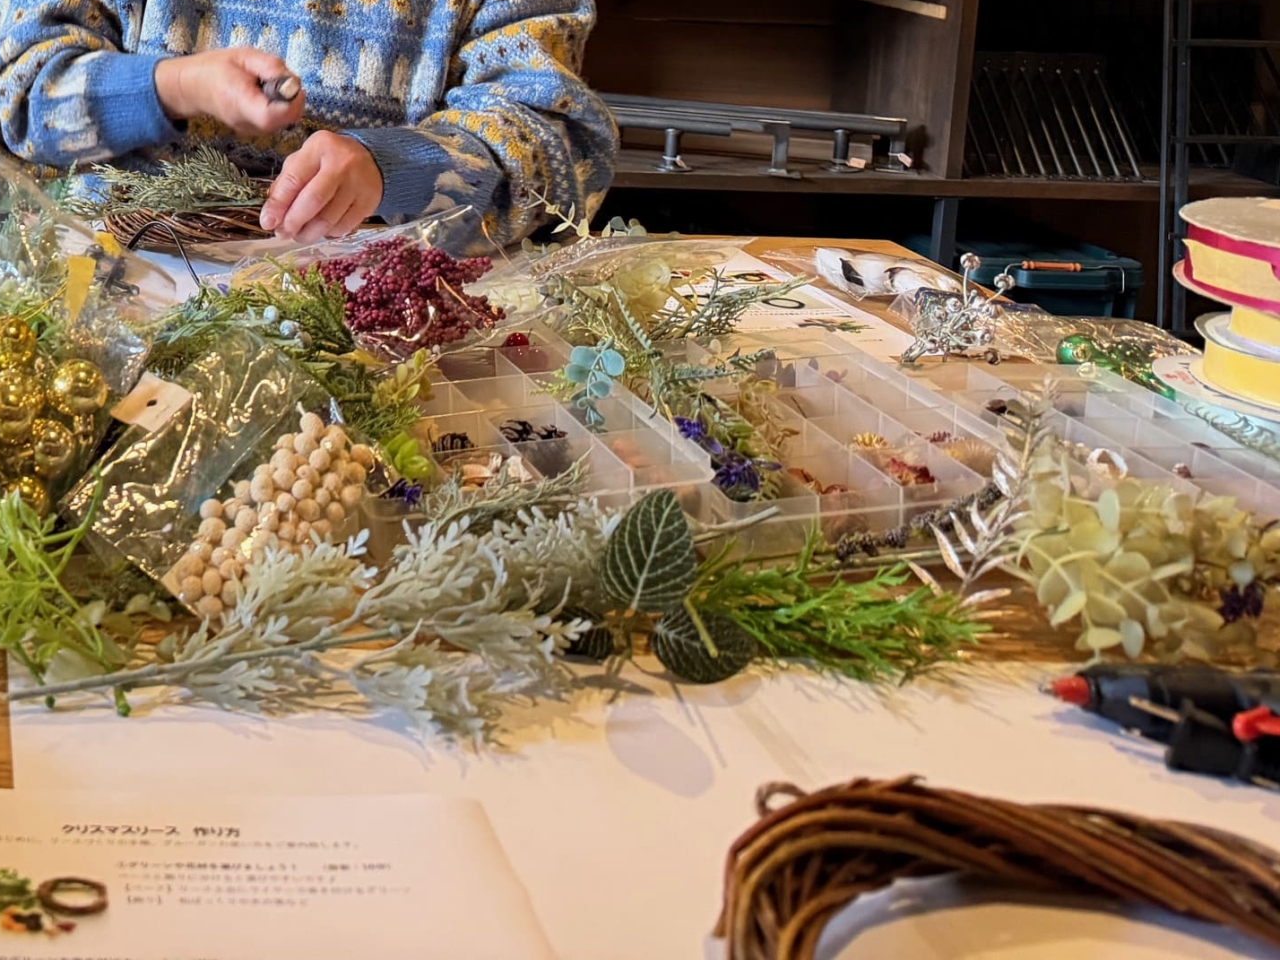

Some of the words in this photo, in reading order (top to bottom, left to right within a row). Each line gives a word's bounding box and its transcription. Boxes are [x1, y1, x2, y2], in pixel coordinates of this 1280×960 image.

[62, 824, 180, 836] クリスマスリース
